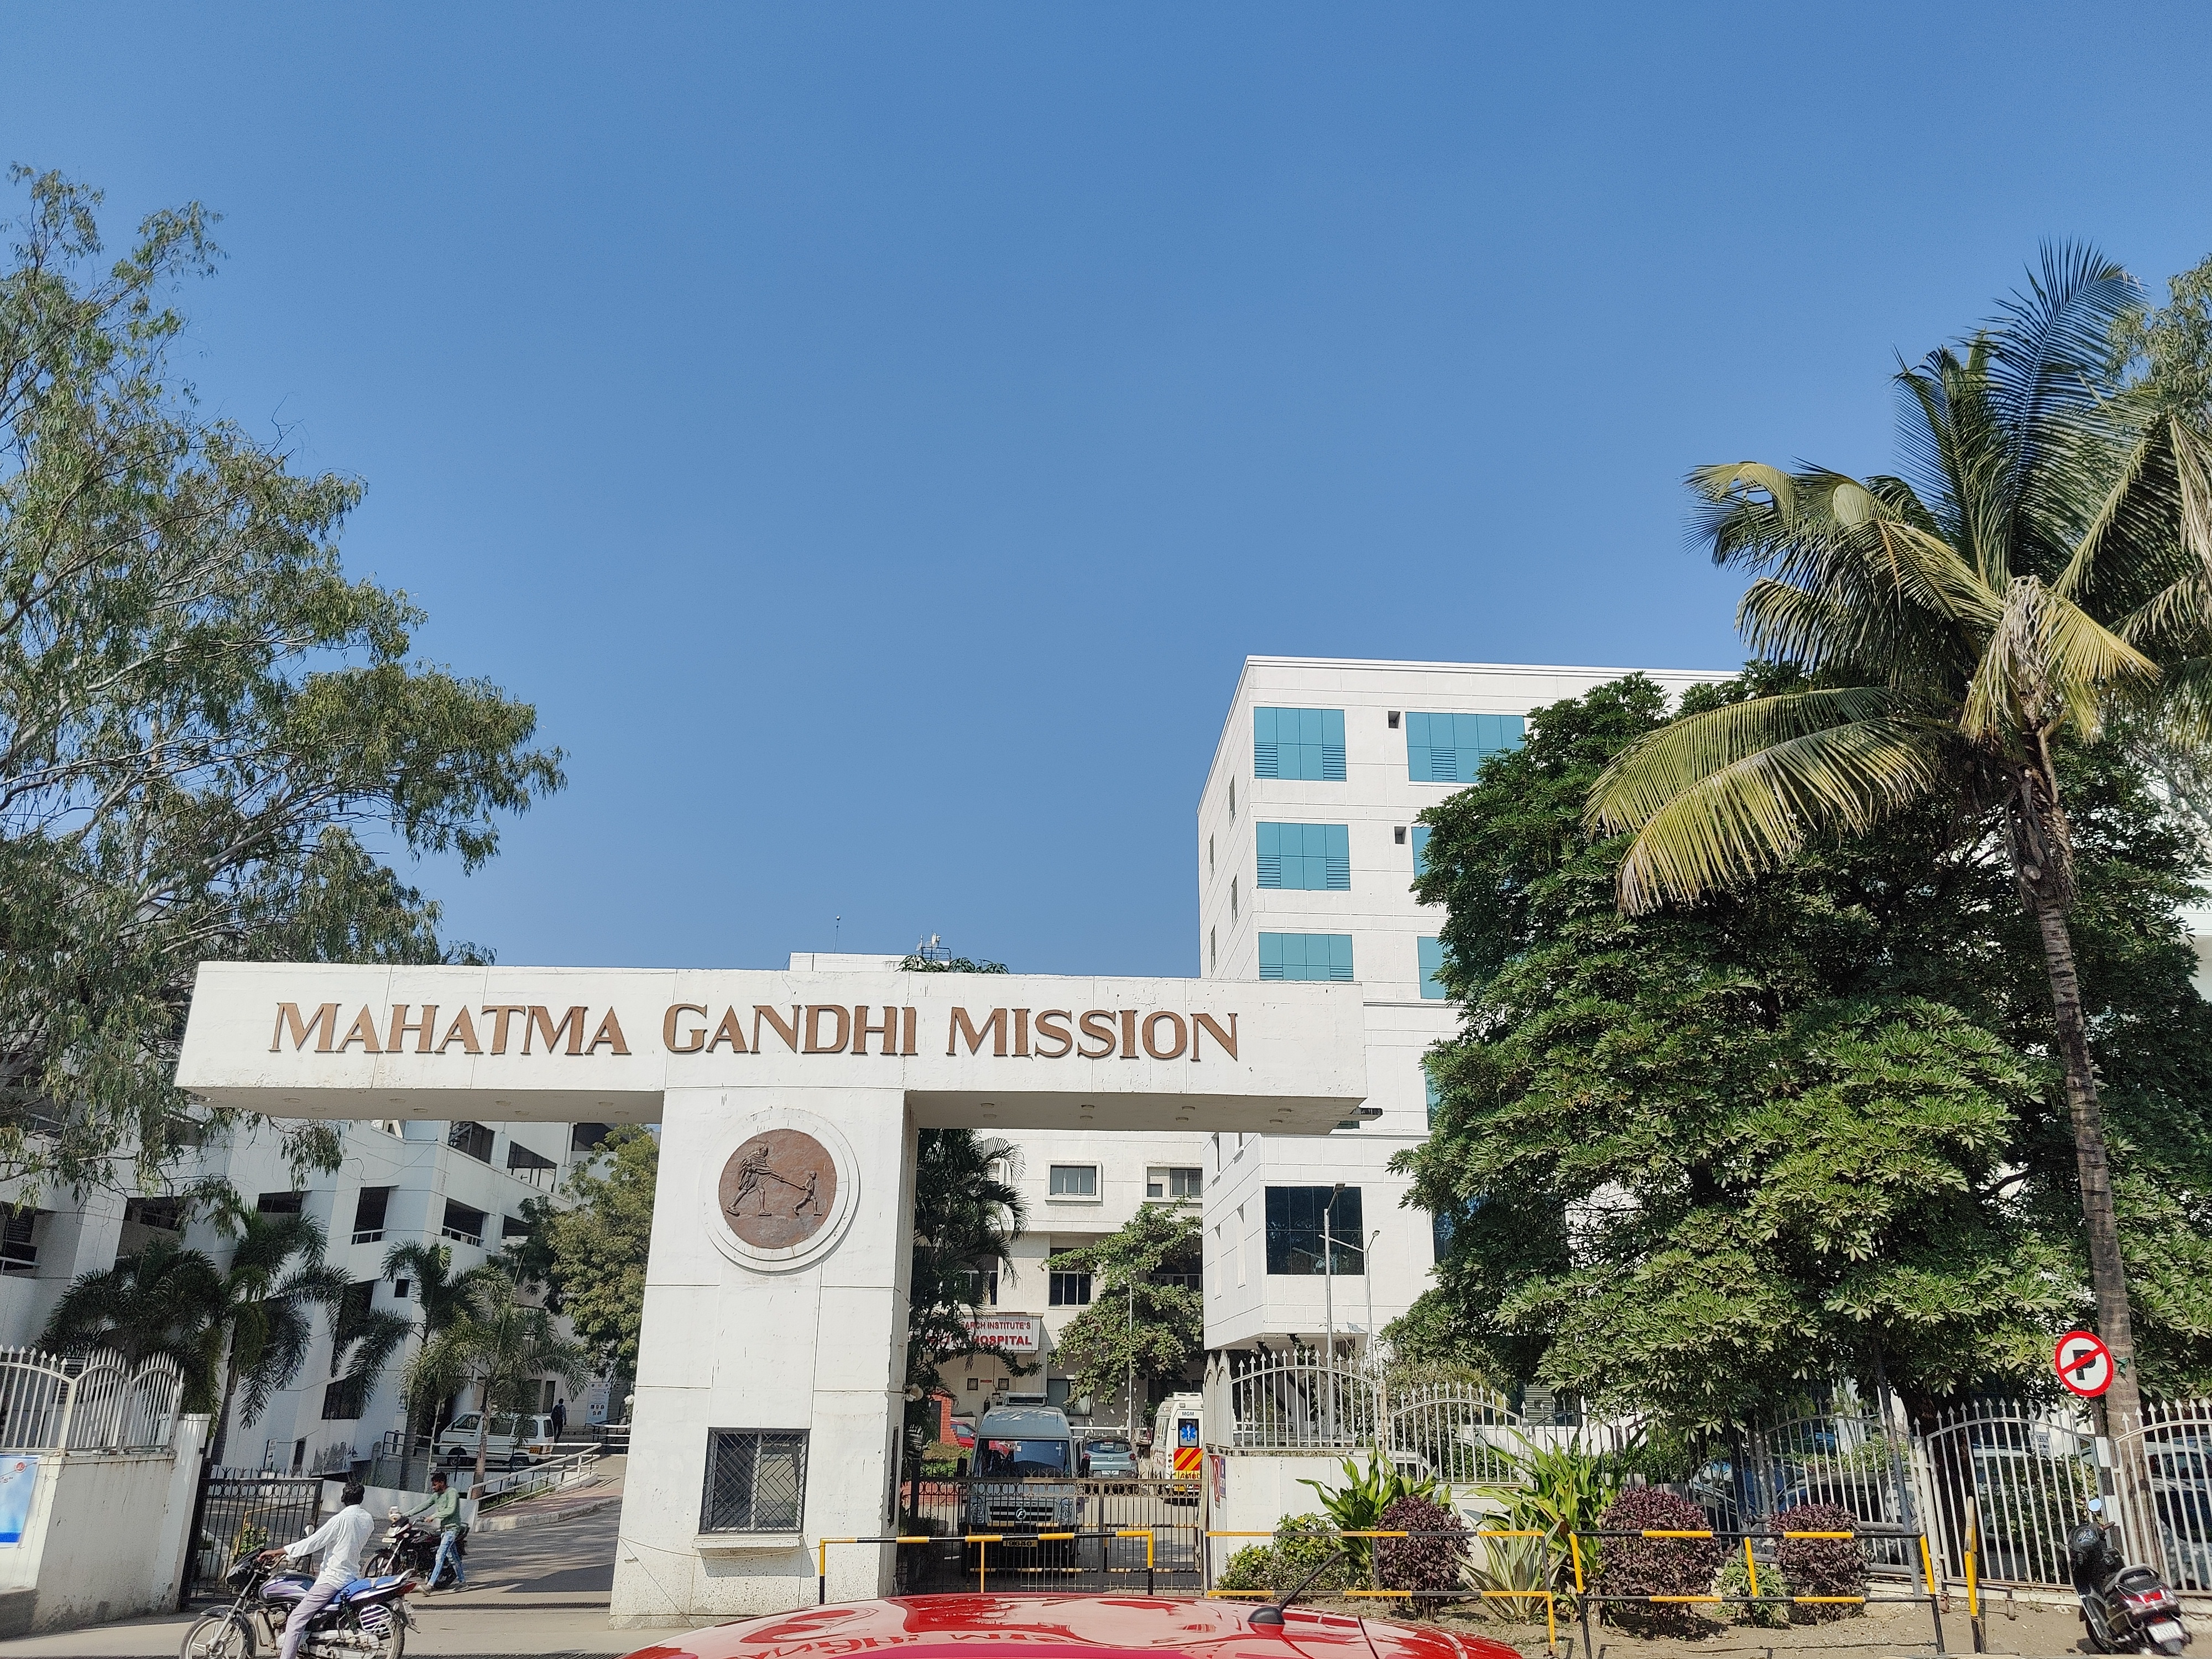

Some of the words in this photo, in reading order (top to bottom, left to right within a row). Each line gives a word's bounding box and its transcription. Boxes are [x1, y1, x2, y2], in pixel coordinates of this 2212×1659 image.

[268, 1002, 632, 1056] MAHATMA
[662, 1003, 919, 1057] GANDHI
[946, 1006, 1239, 1062] MISSION
[987, 1321, 1031, 1330] INSTITUTE'S
[972, 1335, 1032, 1346] HOSPITAL
